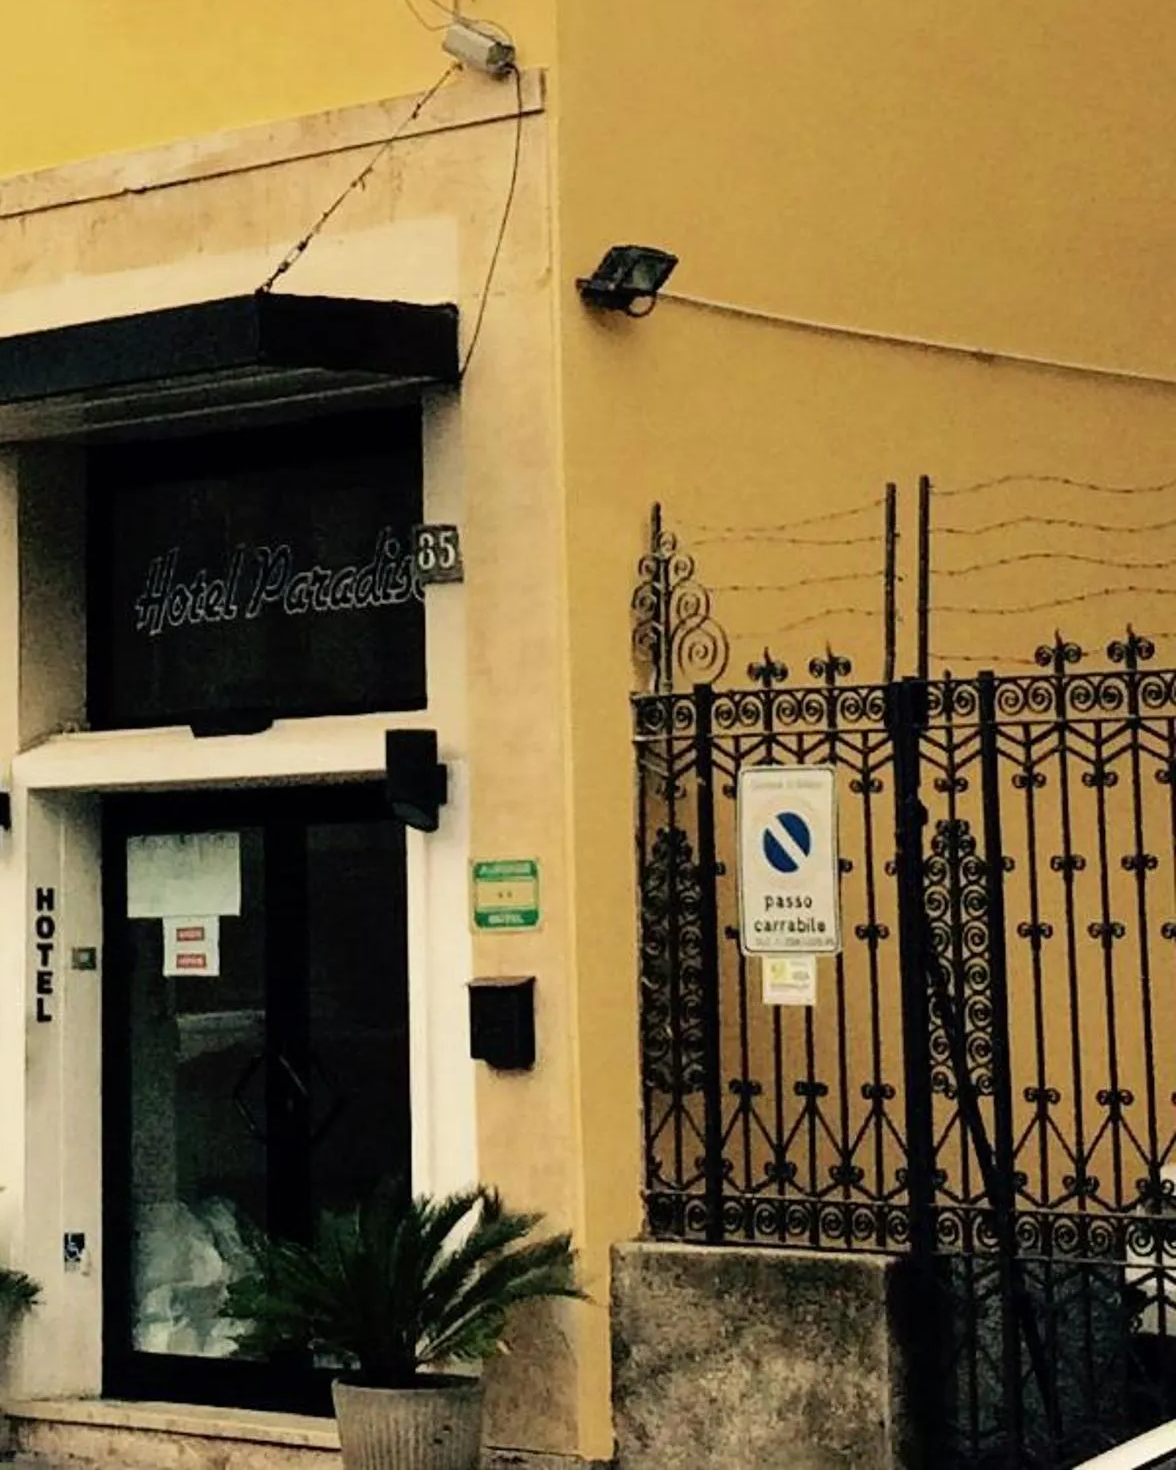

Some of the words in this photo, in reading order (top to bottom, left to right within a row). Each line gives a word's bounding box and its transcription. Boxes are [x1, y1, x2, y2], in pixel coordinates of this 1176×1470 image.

[136, 547, 247, 636] Hotel
[754, 917, 826, 933] carrabile
[765, 895, 813, 911] passo
[36, 888, 55, 1022] HOTEL
